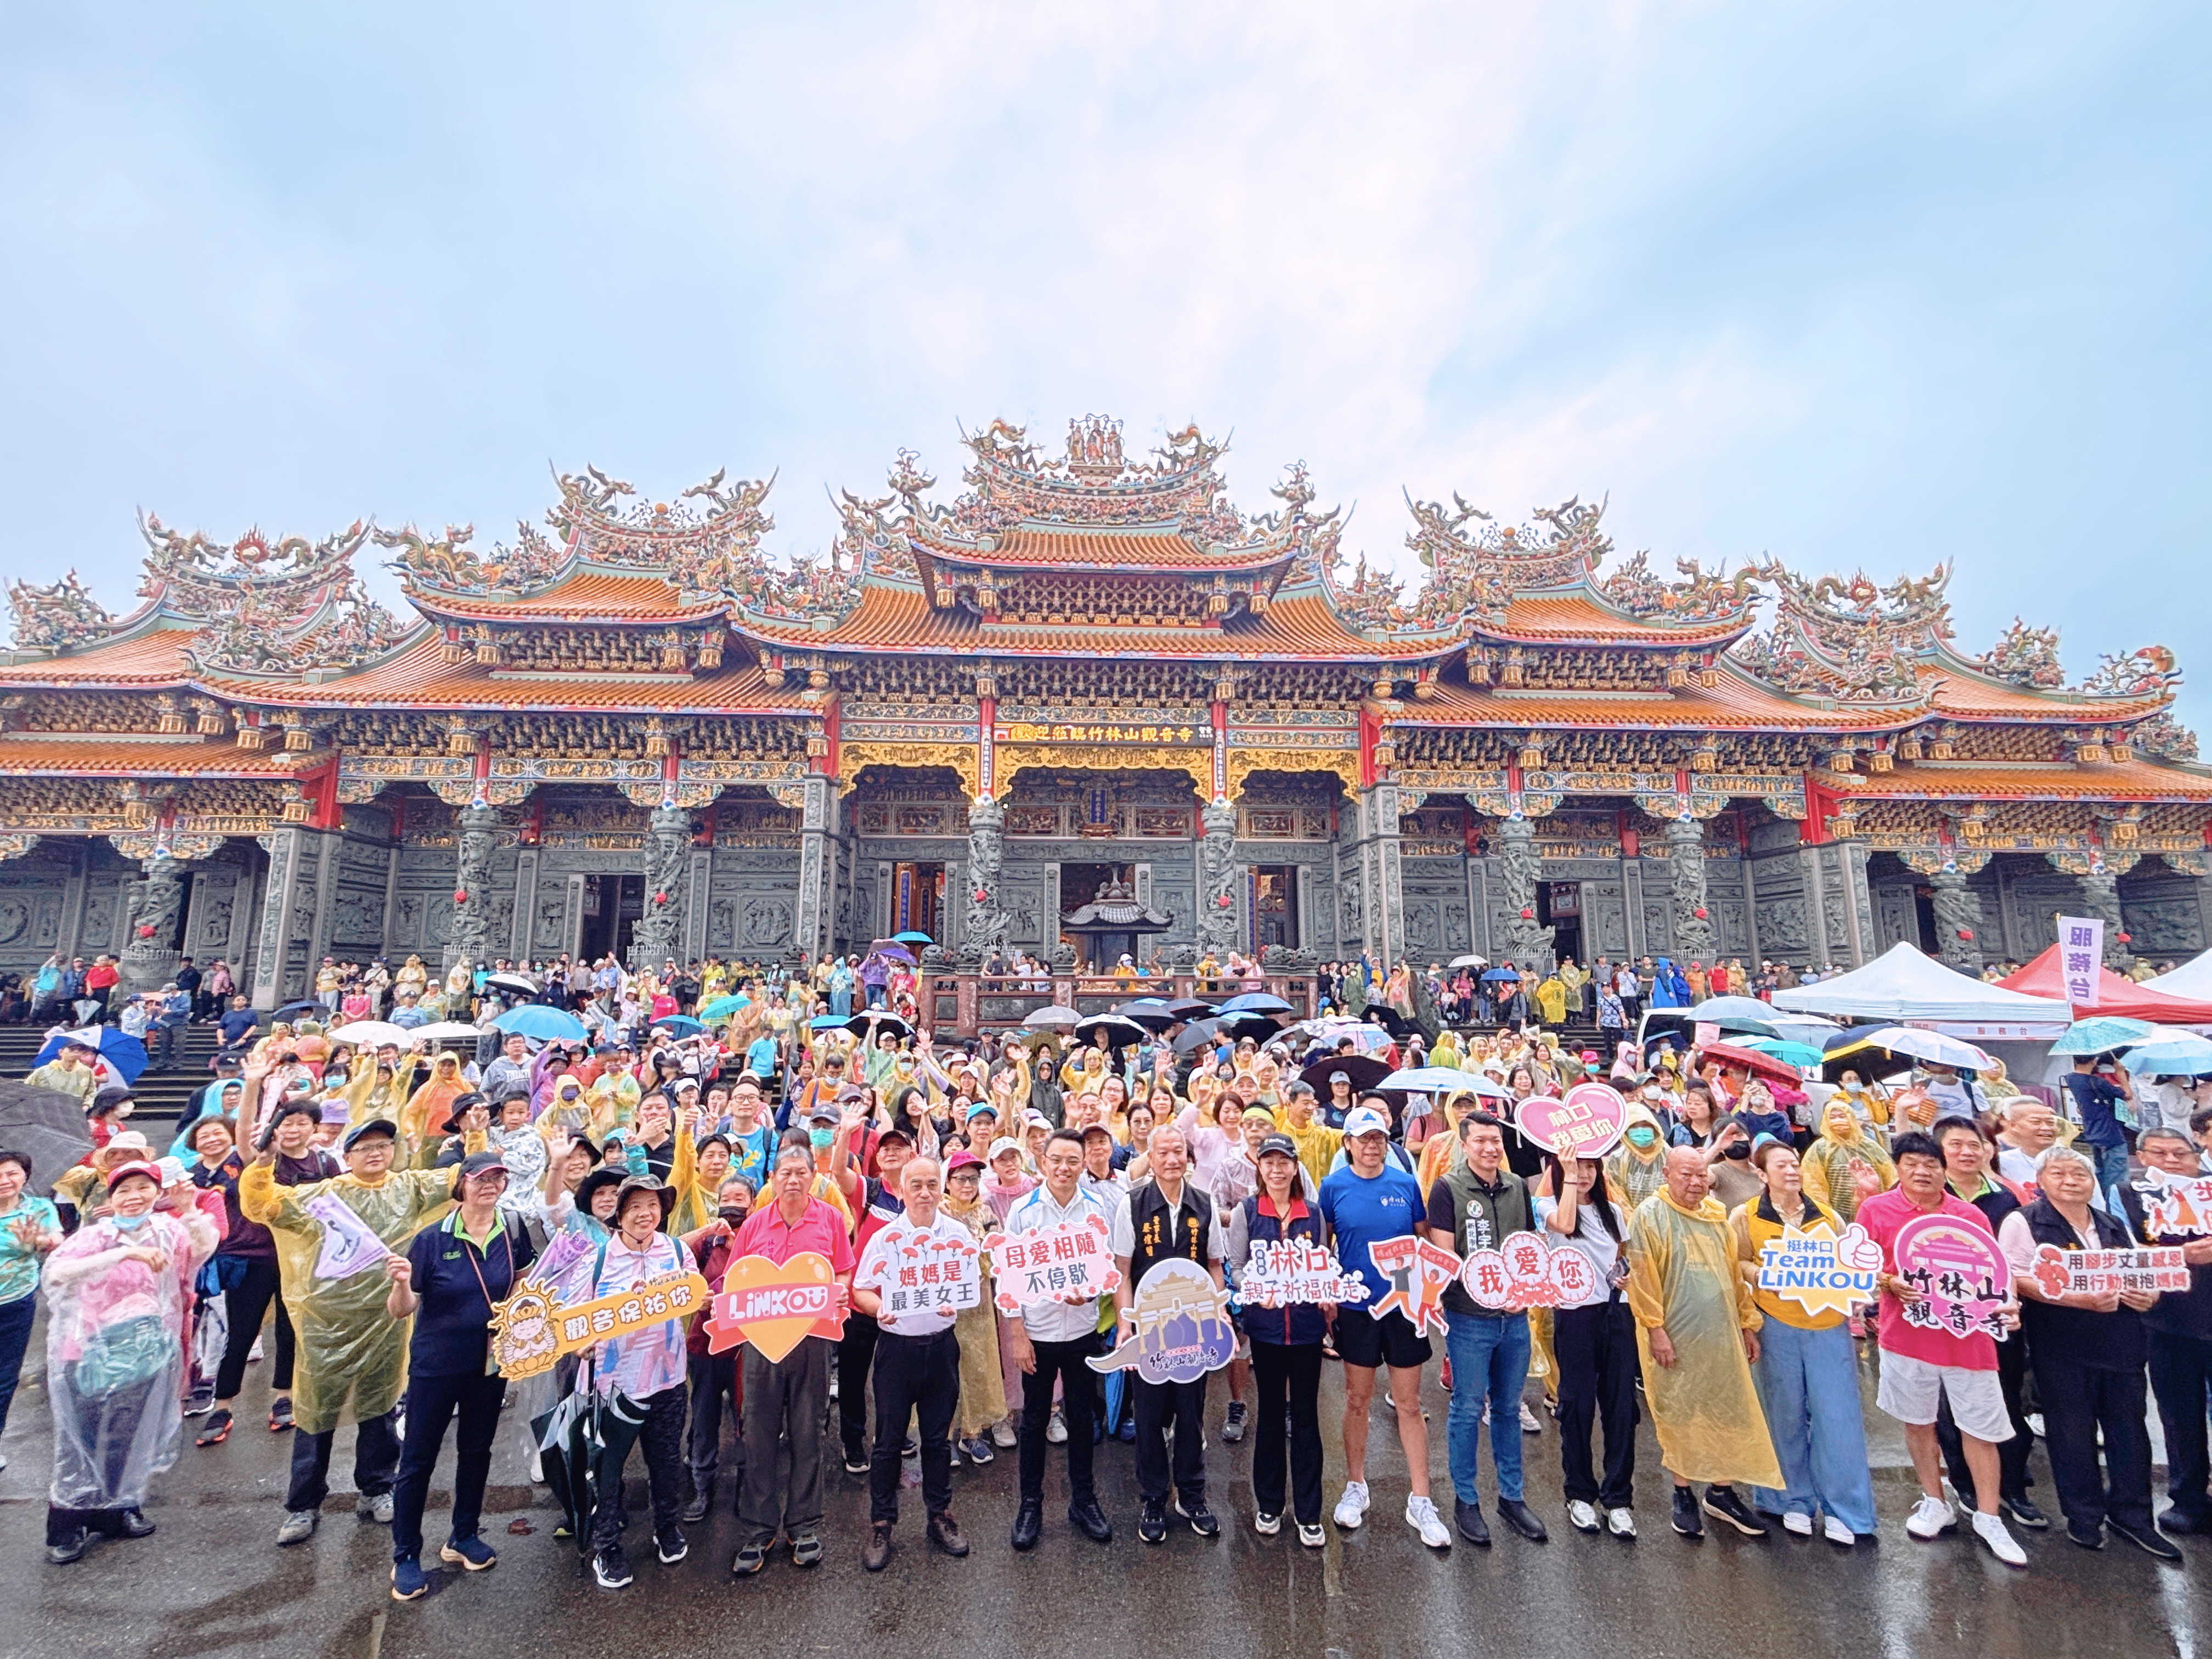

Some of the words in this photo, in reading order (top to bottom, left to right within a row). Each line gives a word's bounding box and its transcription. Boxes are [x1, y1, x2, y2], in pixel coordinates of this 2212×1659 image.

[1015, 725, 1193, 743] 歡迎蒞臨竹林山觀音寺
[1548, 1102, 1593, 1127] 林口
[1548, 1118, 1617, 1148] 我愛你
[1006, 1232, 1097, 1268] 母愛相隨
[1270, 1242, 1328, 1277] 林口
[1763, 1251, 1835, 1268] Team
[1787, 1240, 1833, 1253] 挺林口
[899, 1260, 962, 1289] 媽媽是
[1025, 1262, 1089, 1293] 不停歇
[1904, 1267, 2008, 1304] 竹林山
[891, 1283, 973, 1311] 最美女王
[1244, 1279, 1359, 1301] 親子祈福健走
[565, 1285, 692, 1342] 觀音保祐你
[1907, 1301, 2009, 1338] 觀音寺
